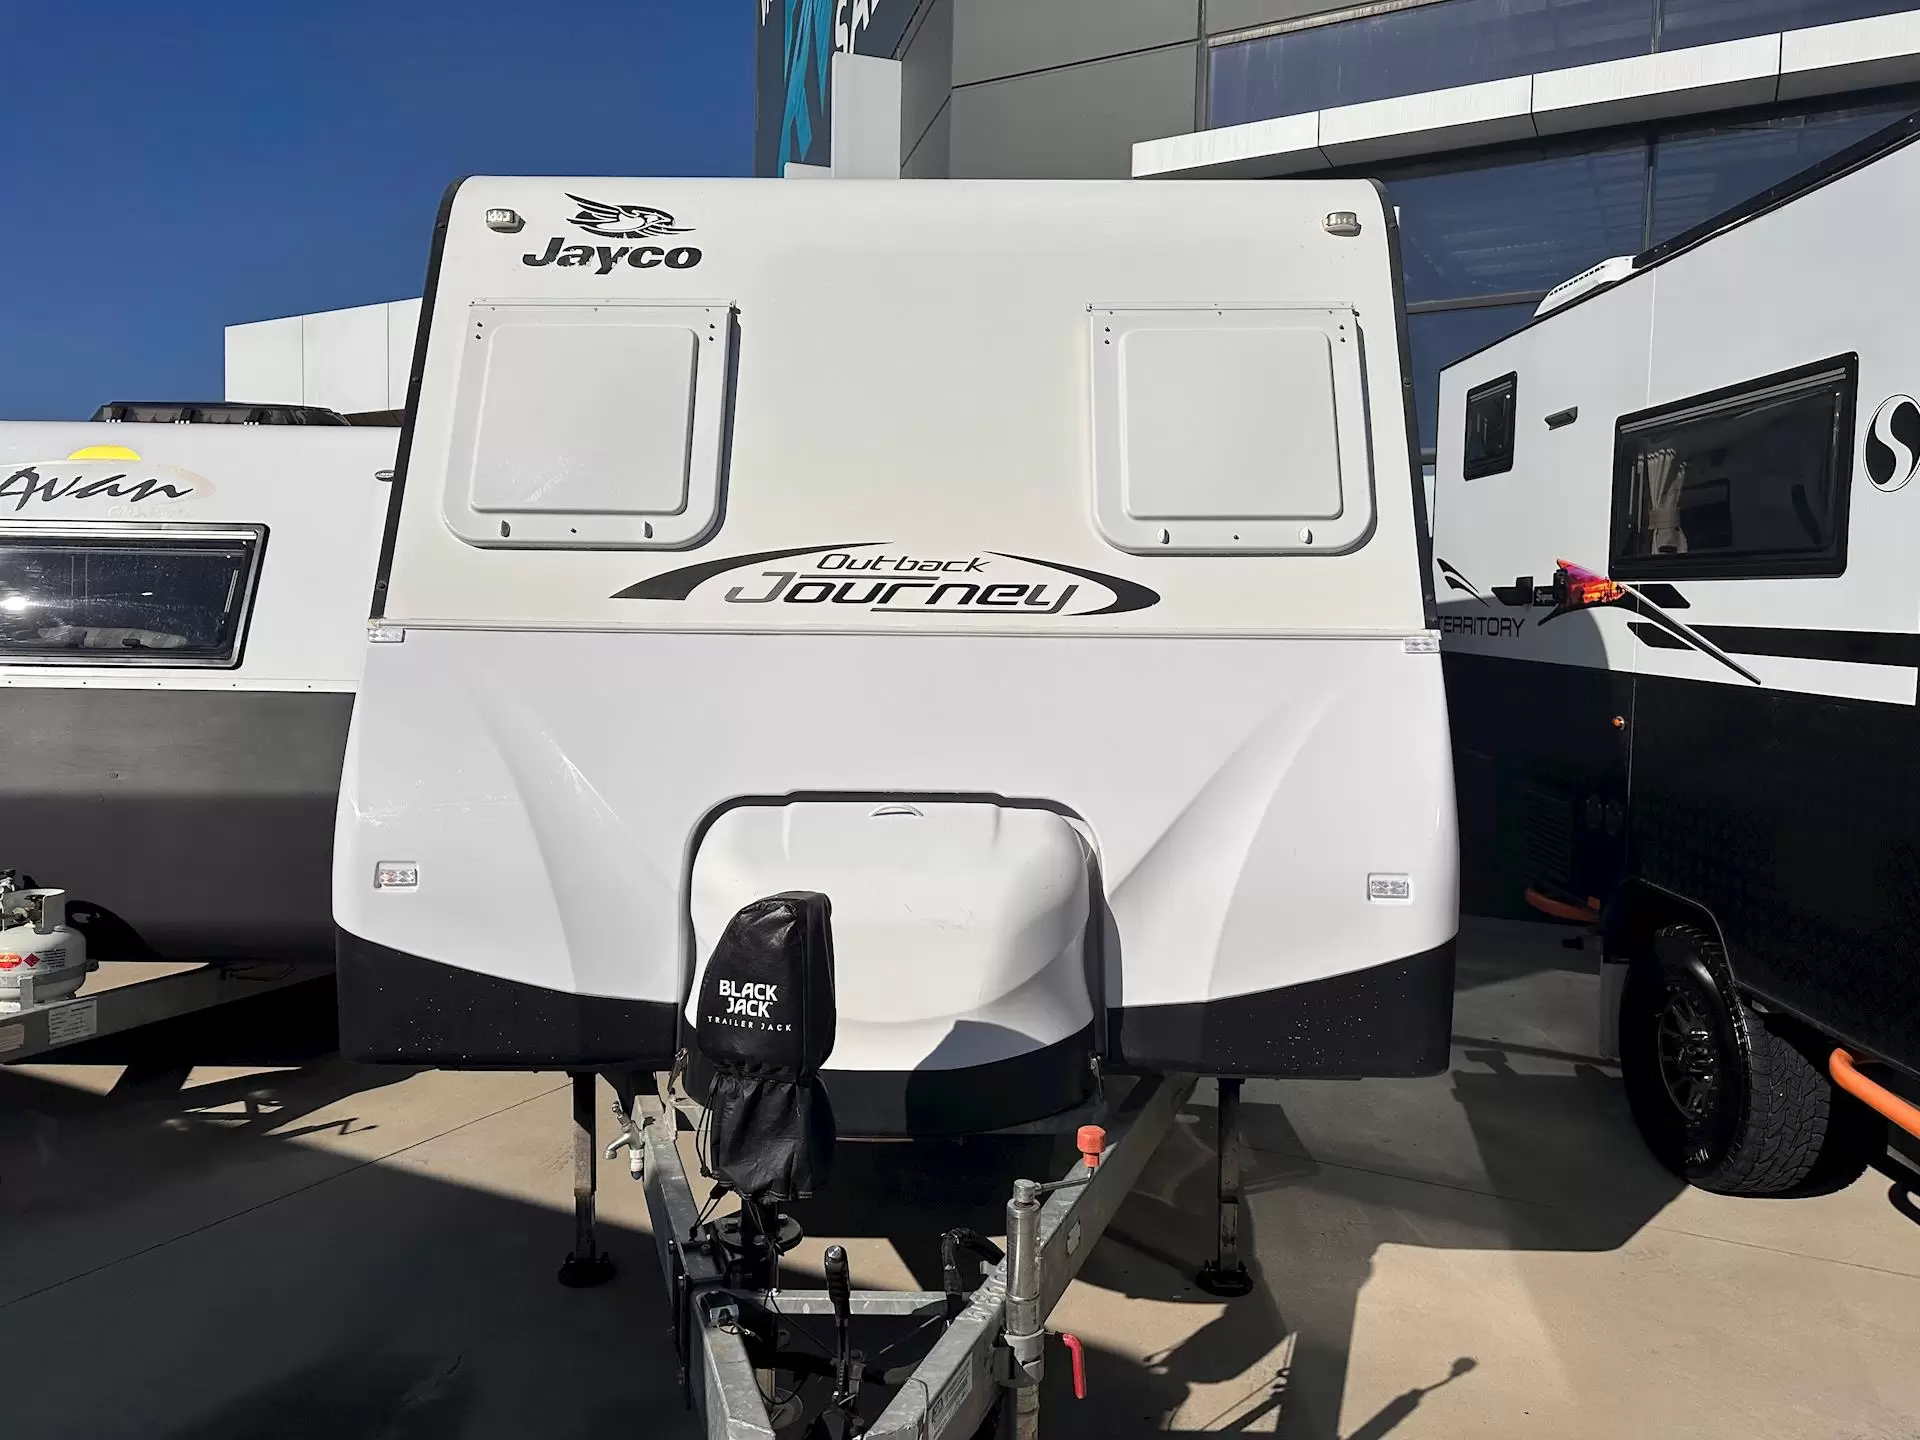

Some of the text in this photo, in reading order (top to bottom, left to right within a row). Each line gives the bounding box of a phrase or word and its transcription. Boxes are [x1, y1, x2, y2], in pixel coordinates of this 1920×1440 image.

[522, 237, 703, 275] Jayco
[0, 466, 193, 511] Avan
[816, 553, 991, 573] Outback
[723, 571, 1080, 614] Journey
[719, 979, 778, 1002] BLACK
[726, 997, 772, 1018] JACK
[707, 1016, 792, 1032] TRAILER JACK
